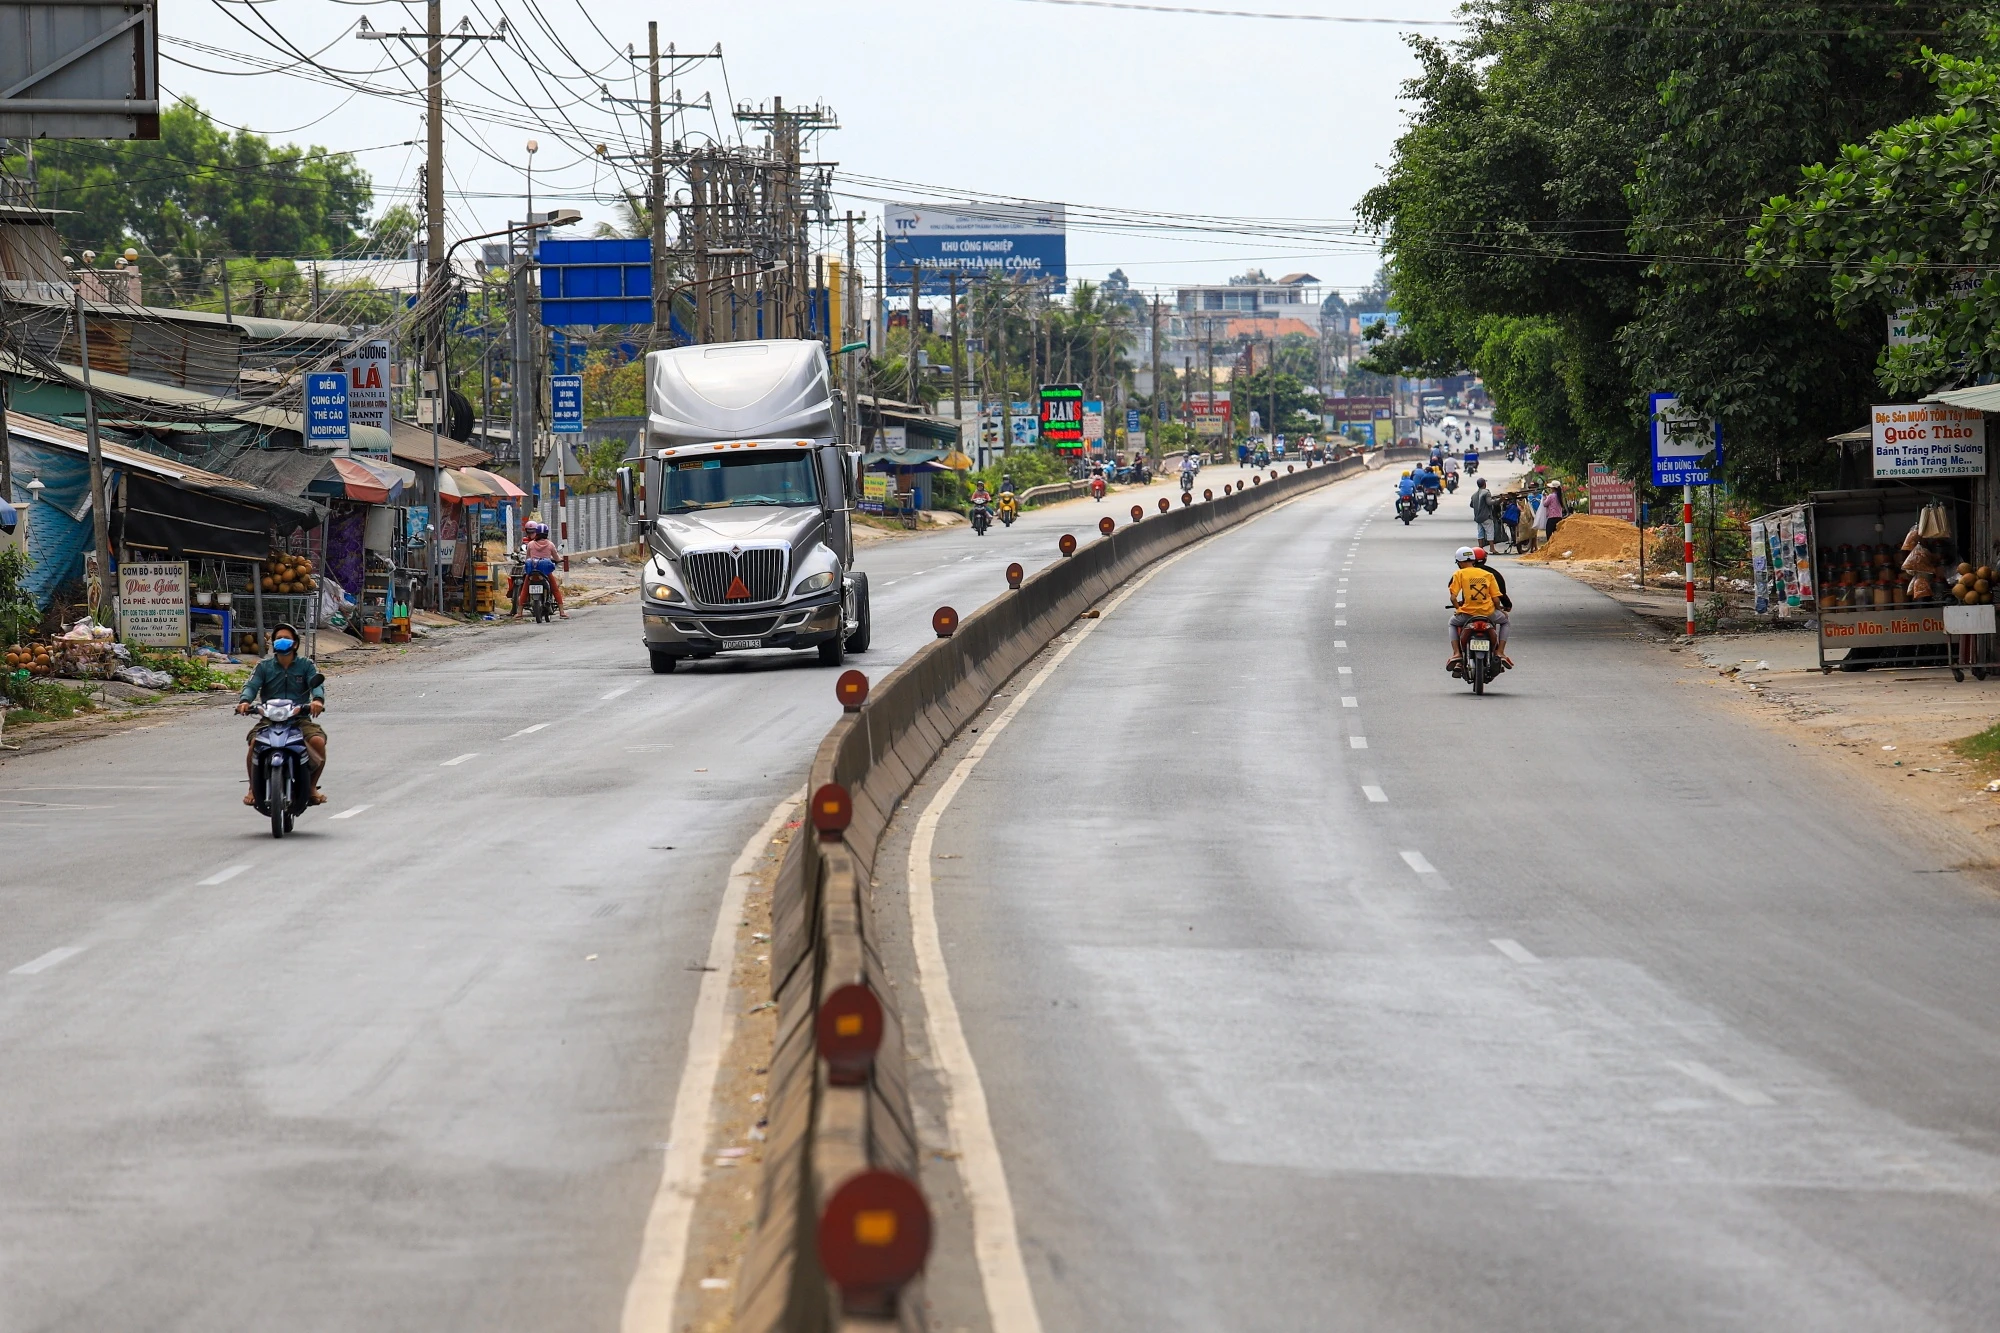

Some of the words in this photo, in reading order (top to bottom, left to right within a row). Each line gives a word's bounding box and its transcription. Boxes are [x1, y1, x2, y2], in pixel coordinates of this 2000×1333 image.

[896, 219, 917, 229] TTC
[941, 241, 958, 252] KHU
[960, 239, 981, 252] CÔNG
[983, 238, 1014, 253] NGHIỆP
[1006, 254, 1041, 270] CÔNG
[352, 362, 383, 388] LÁ
[319, 377, 337, 390] ĐIỂM
[311, 396, 331, 405] CUNG
[331, 392, 345, 405] CẤP
[313, 407, 328, 420] THẺ
[329, 408, 343, 420] CÀO
[1041, 401, 1082, 421] JEANS
[1875, 412, 1890, 426] Đặc
[1892, 410, 1907, 423] Sản
[1930, 408, 1947, 421] TÔM
[311, 425, 347, 435] MOBIFONE
[1884, 424, 1927, 444] Quốc
[1931, 423, 1973, 439] Thảo
[1876, 445, 1899, 456] Bánh
[1902, 445, 1929, 456] Tráng
[1931, 444, 1951, 454] Phơi
[1954, 443, 1983, 455] Sương
[1657, 458, 1674, 471] ĐIỂM
[1677, 459, 1692, 470] DỪNG
[1895, 456, 1918, 467] Bánh
[1921, 456, 1947, 467] Tráng
[1950, 455, 1972, 465] Me...
[1590, 476, 1616, 487] QUANG
[1662, 473, 1681, 484] BUS
[122, 597, 132, 605] CÀ
[133, 596, 146, 605] PHÊ
[151, 597, 171, 605] NƯỚC
[172, 597, 184, 605] MÍA
[1857, 620, 1883, 635] Môn
[1891, 617, 1920, 635] Mắm
[1922, 617, 1945, 632] Chu
